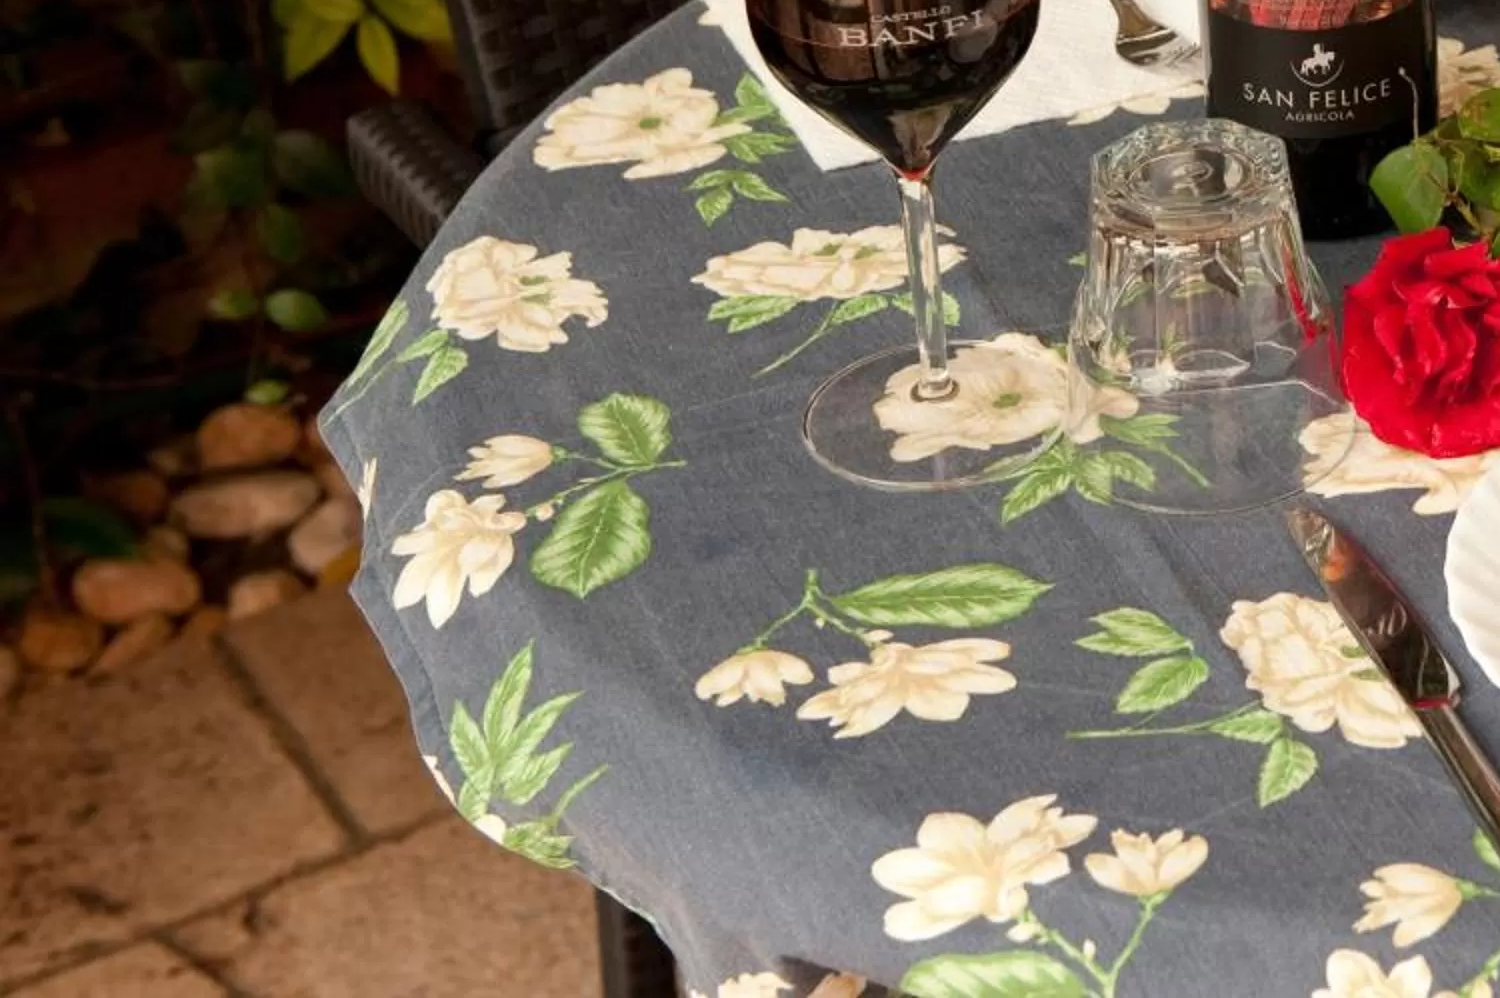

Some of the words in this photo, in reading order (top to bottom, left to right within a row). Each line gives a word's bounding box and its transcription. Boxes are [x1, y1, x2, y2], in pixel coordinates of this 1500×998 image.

[871, 5, 952, 23] CASTELLO
[837, 9, 987, 48] BANFI
[1242, 82, 1295, 110] SAN
[1310, 77, 1392, 109] FELICE
[1285, 109, 1355, 123] AGRICOLA
